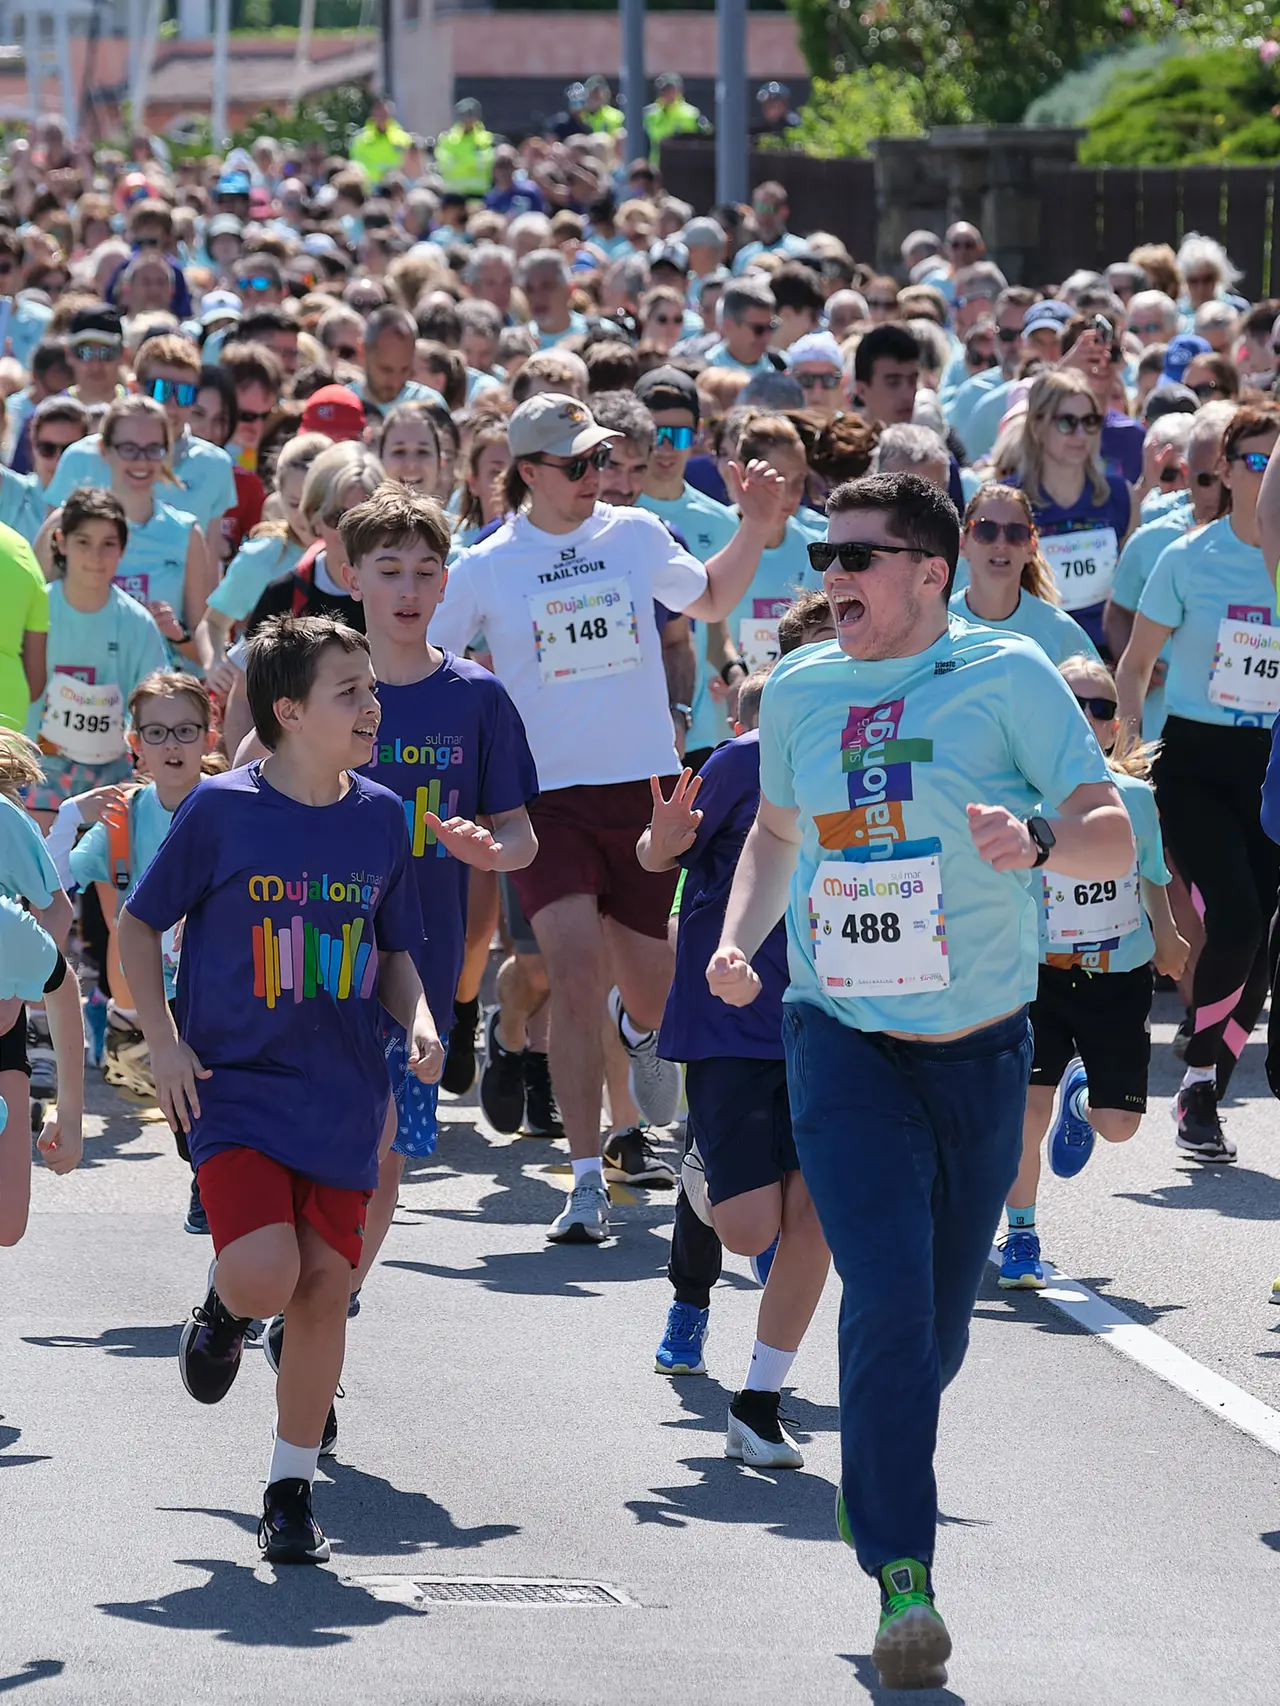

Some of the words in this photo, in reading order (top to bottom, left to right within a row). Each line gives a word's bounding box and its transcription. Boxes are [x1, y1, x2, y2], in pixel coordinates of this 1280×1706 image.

[1061, 558, 1096, 579] 706
[565, 617, 608, 644] 148
[1243, 656, 1280, 679] 145
[63, 710, 110, 733] 1395
[425, 732, 441, 745] sul
[443, 735, 463, 745] mar
[350, 870, 365, 883] sul
[904, 870, 922, 879] mar
[1074, 880, 1117, 906] 629
[841, 912, 901, 944] 488
